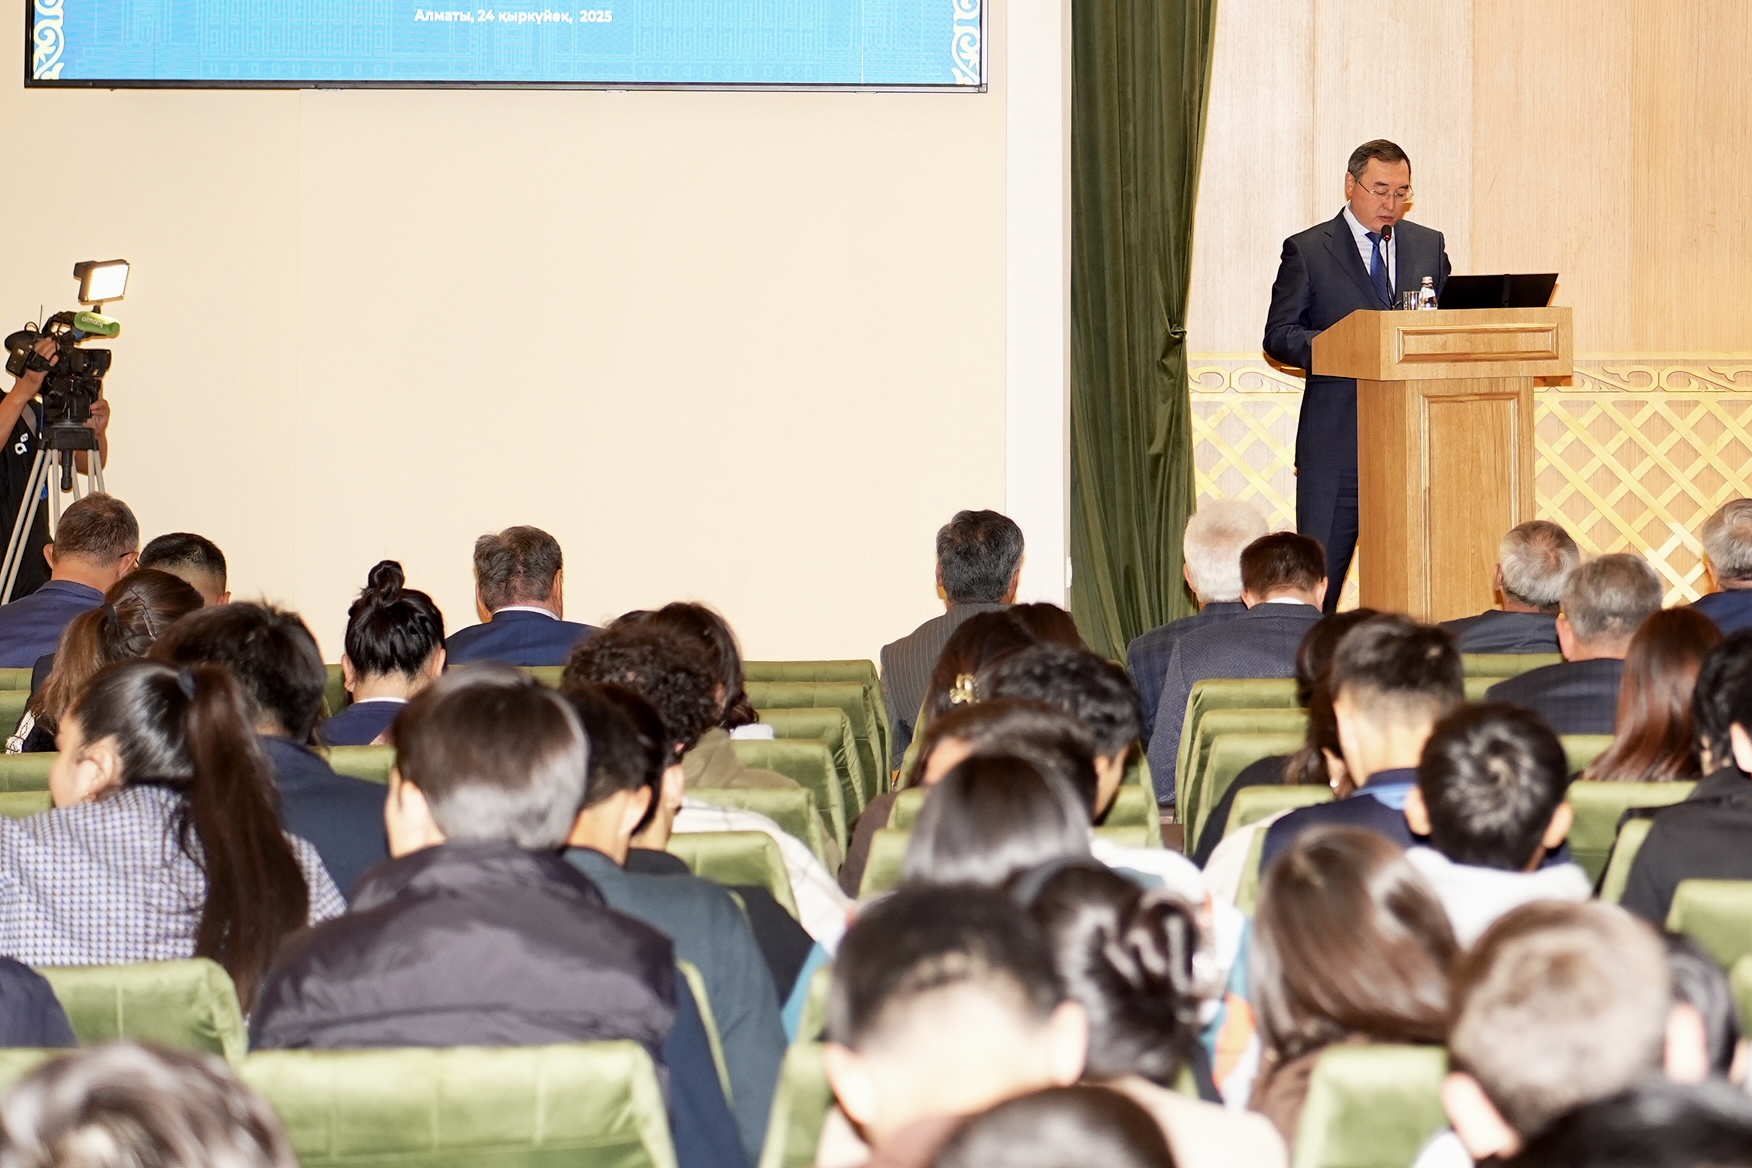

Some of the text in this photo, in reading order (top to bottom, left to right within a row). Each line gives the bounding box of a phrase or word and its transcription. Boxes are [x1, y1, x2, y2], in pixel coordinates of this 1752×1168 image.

[414, 8, 475, 24] Алматы,
[477, 9, 496, 23] 24
[579, 9, 613, 23] 2025
